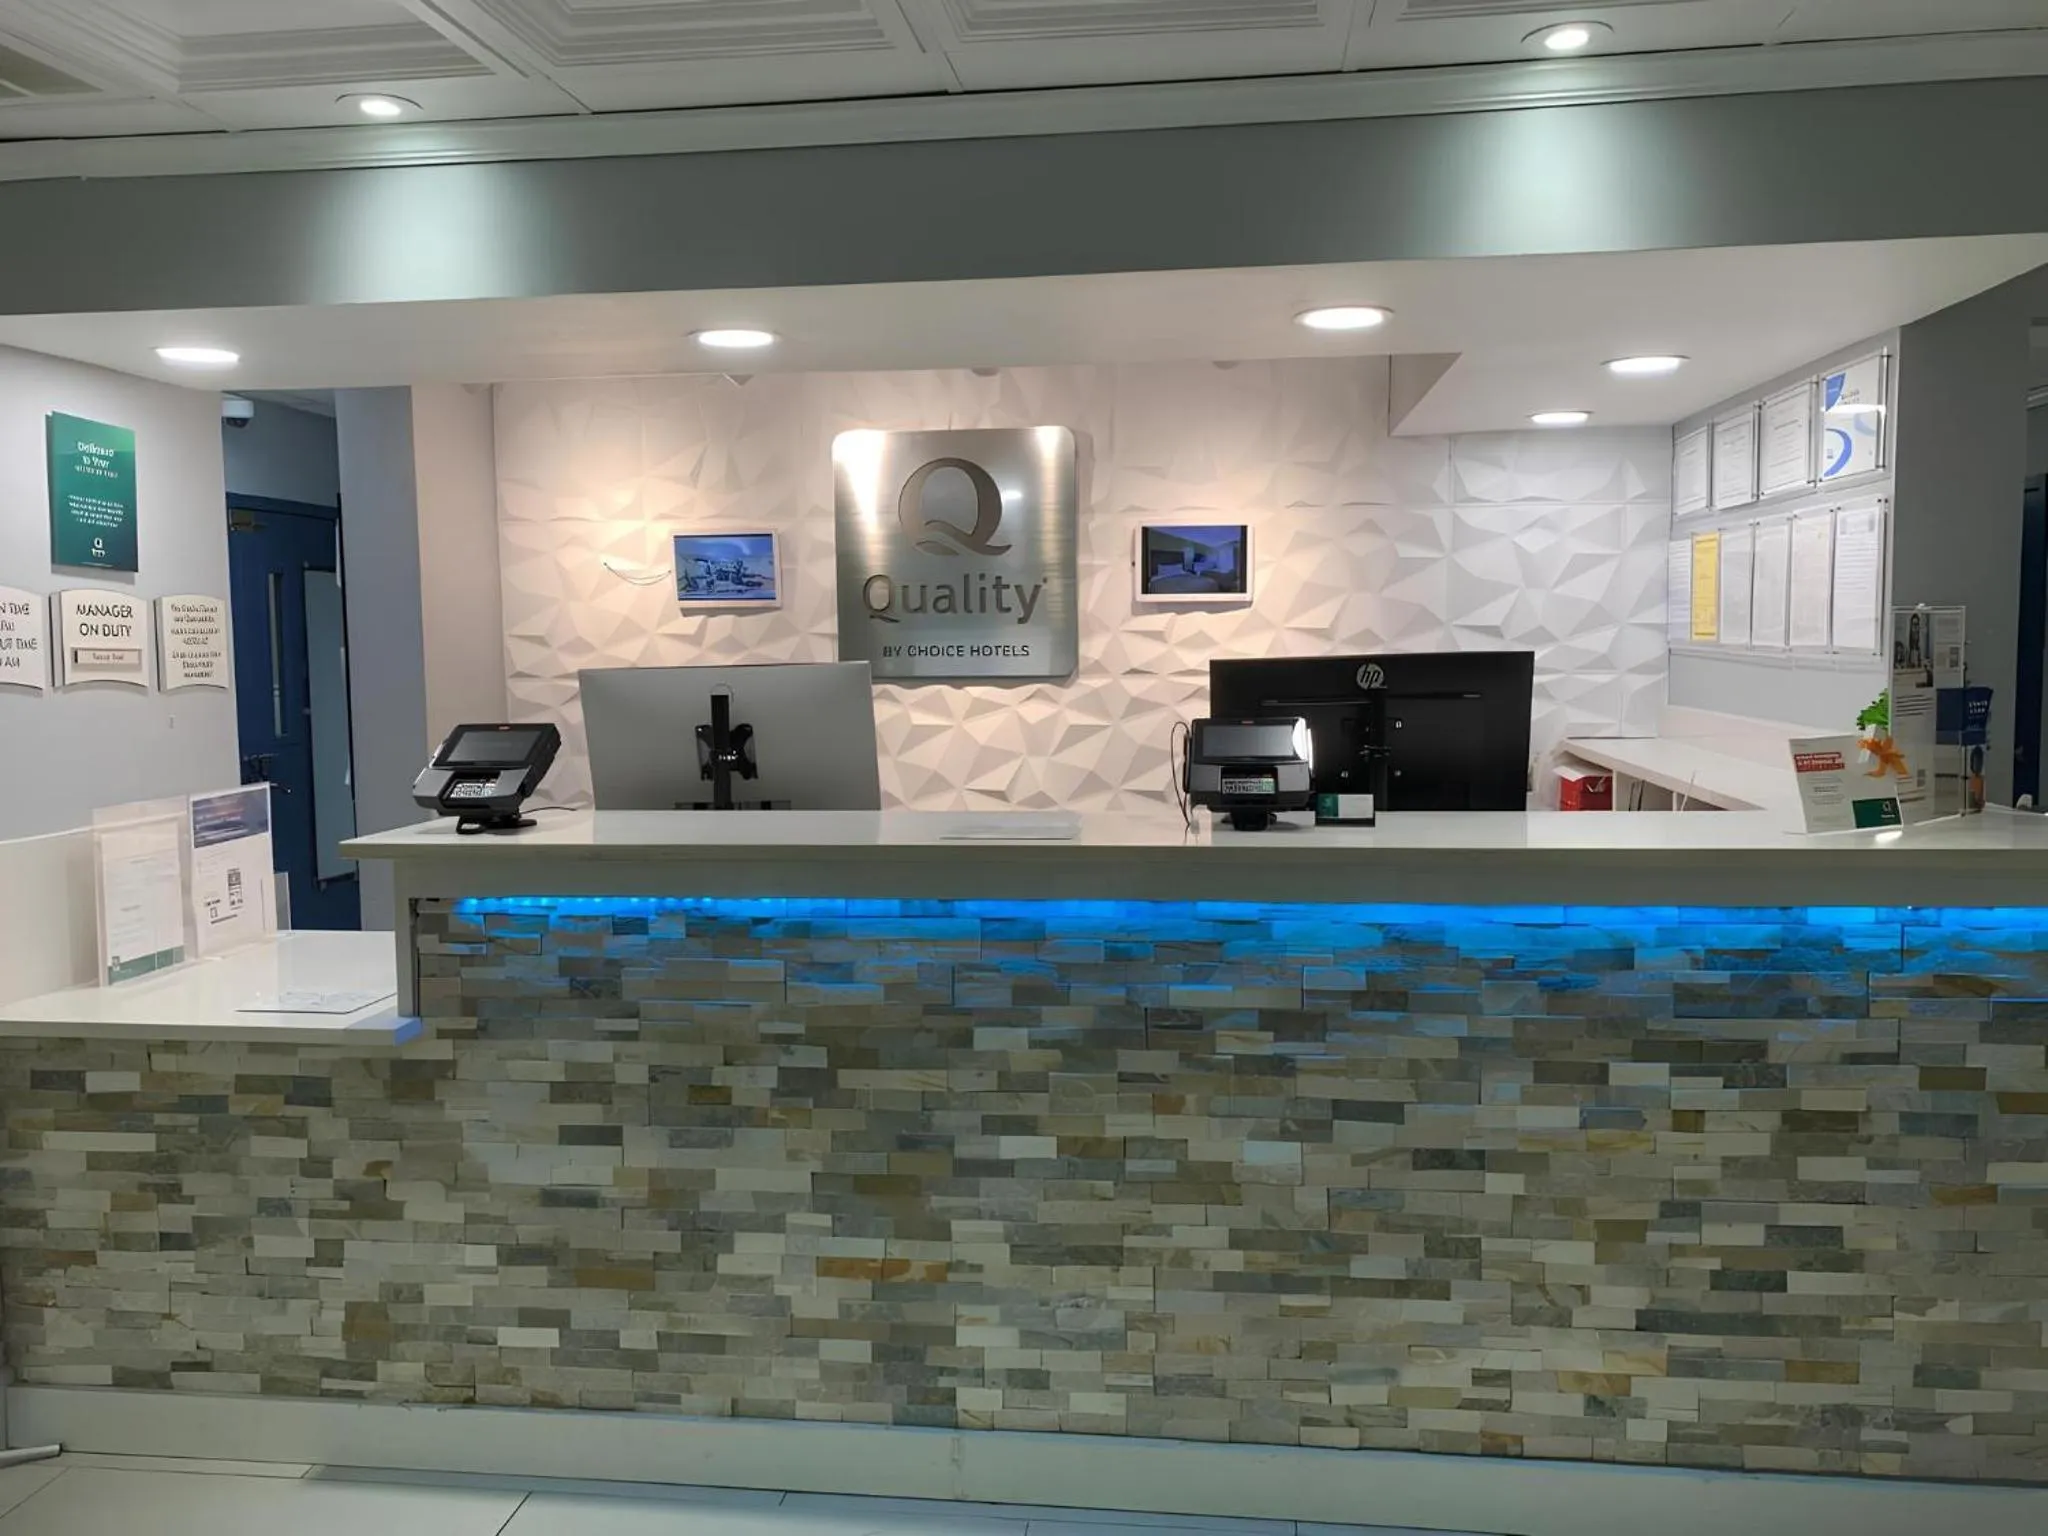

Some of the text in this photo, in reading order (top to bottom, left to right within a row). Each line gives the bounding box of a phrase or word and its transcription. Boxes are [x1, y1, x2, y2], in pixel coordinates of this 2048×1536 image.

[863, 573, 1042, 625] Quality
[76, 604, 133, 618] MANAGER
[80, 623, 132, 637] ON DUTY
[882, 645, 1030, 657] BY CHOICE HOTELS
[1356, 663, 1384, 690] hp
